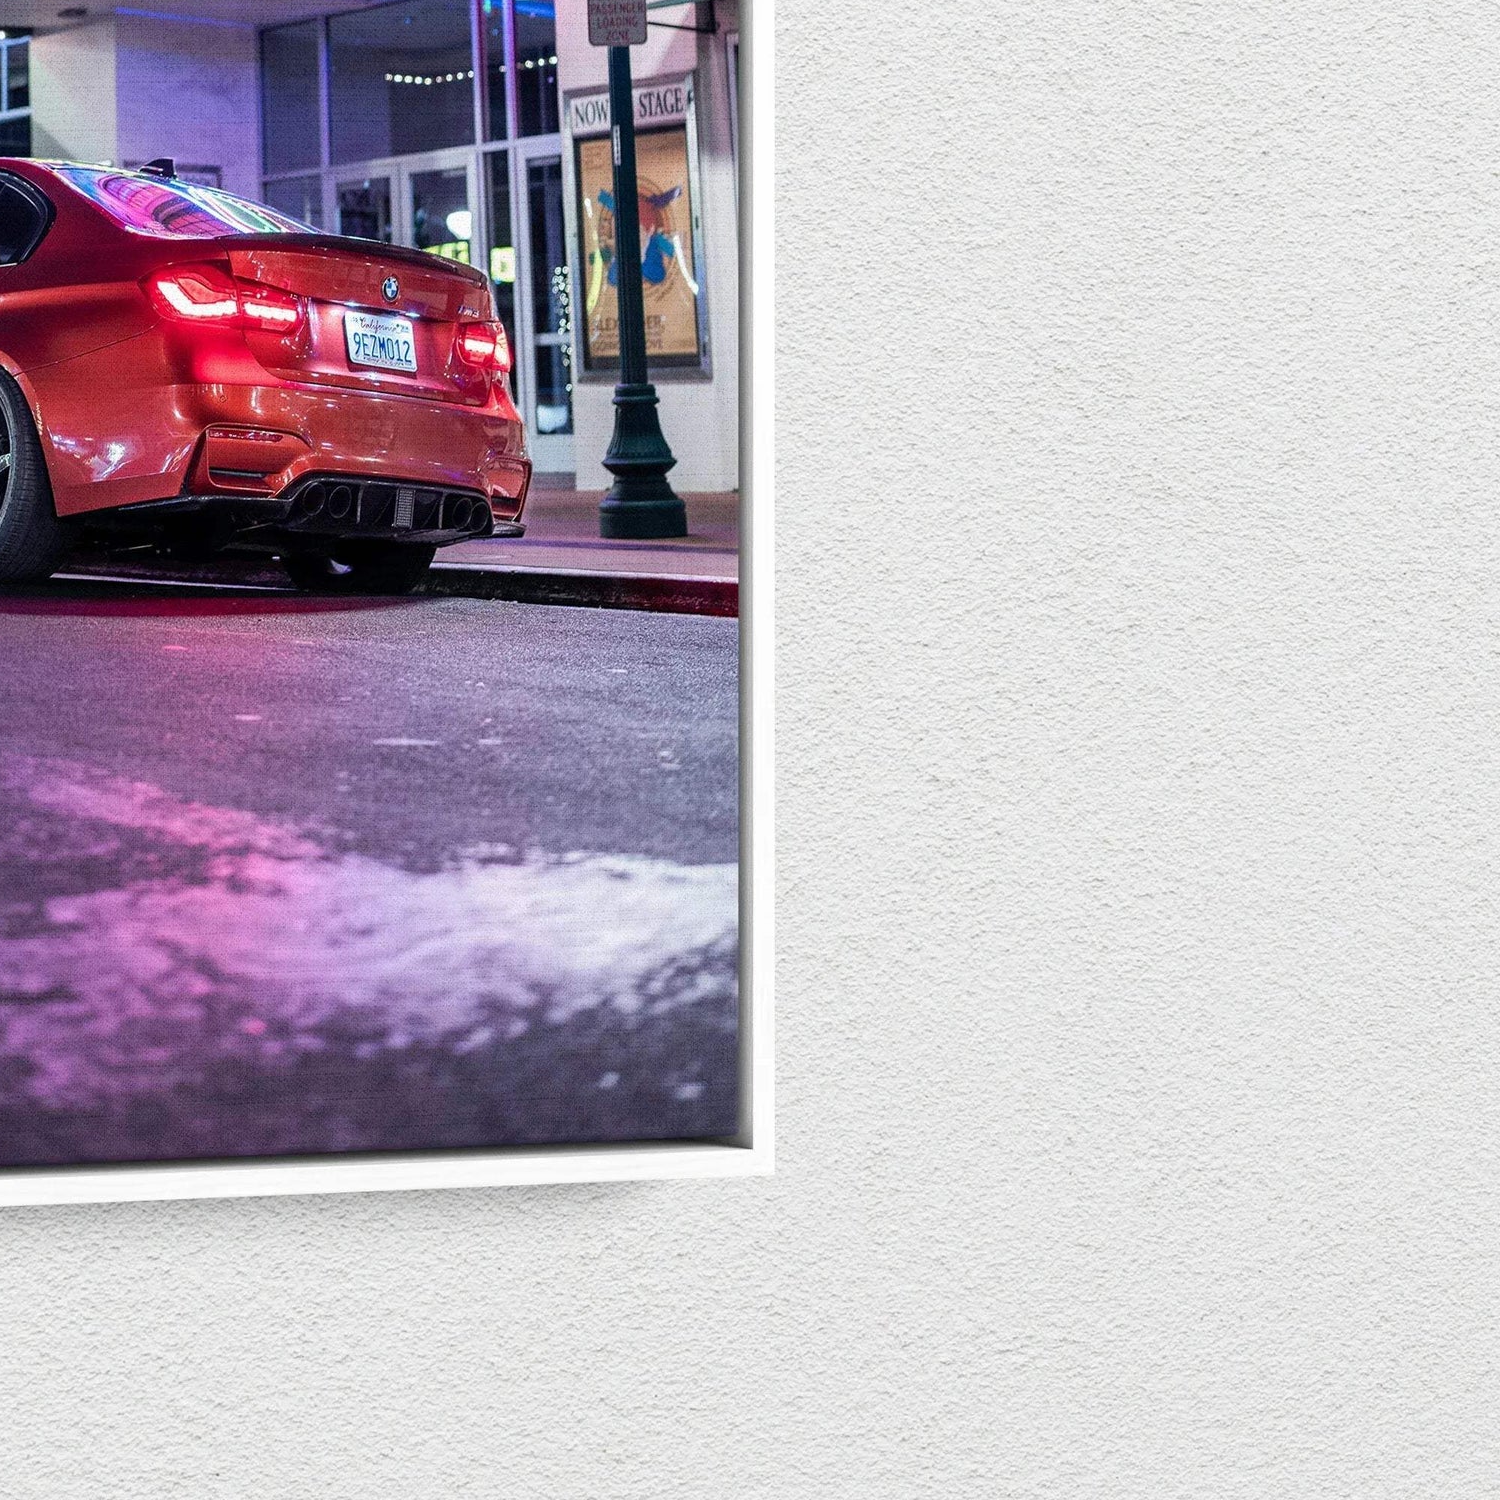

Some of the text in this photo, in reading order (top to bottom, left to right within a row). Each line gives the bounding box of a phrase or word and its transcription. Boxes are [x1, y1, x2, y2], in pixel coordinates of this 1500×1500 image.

[590, 2, 644, 15] PASSENGER
[597, 16, 638, 28] LOADING
[606, 30, 630, 41] ZONE
[574, 87, 684, 129] NOW STAGE
[353, 332, 412, 363] 9EZM012
